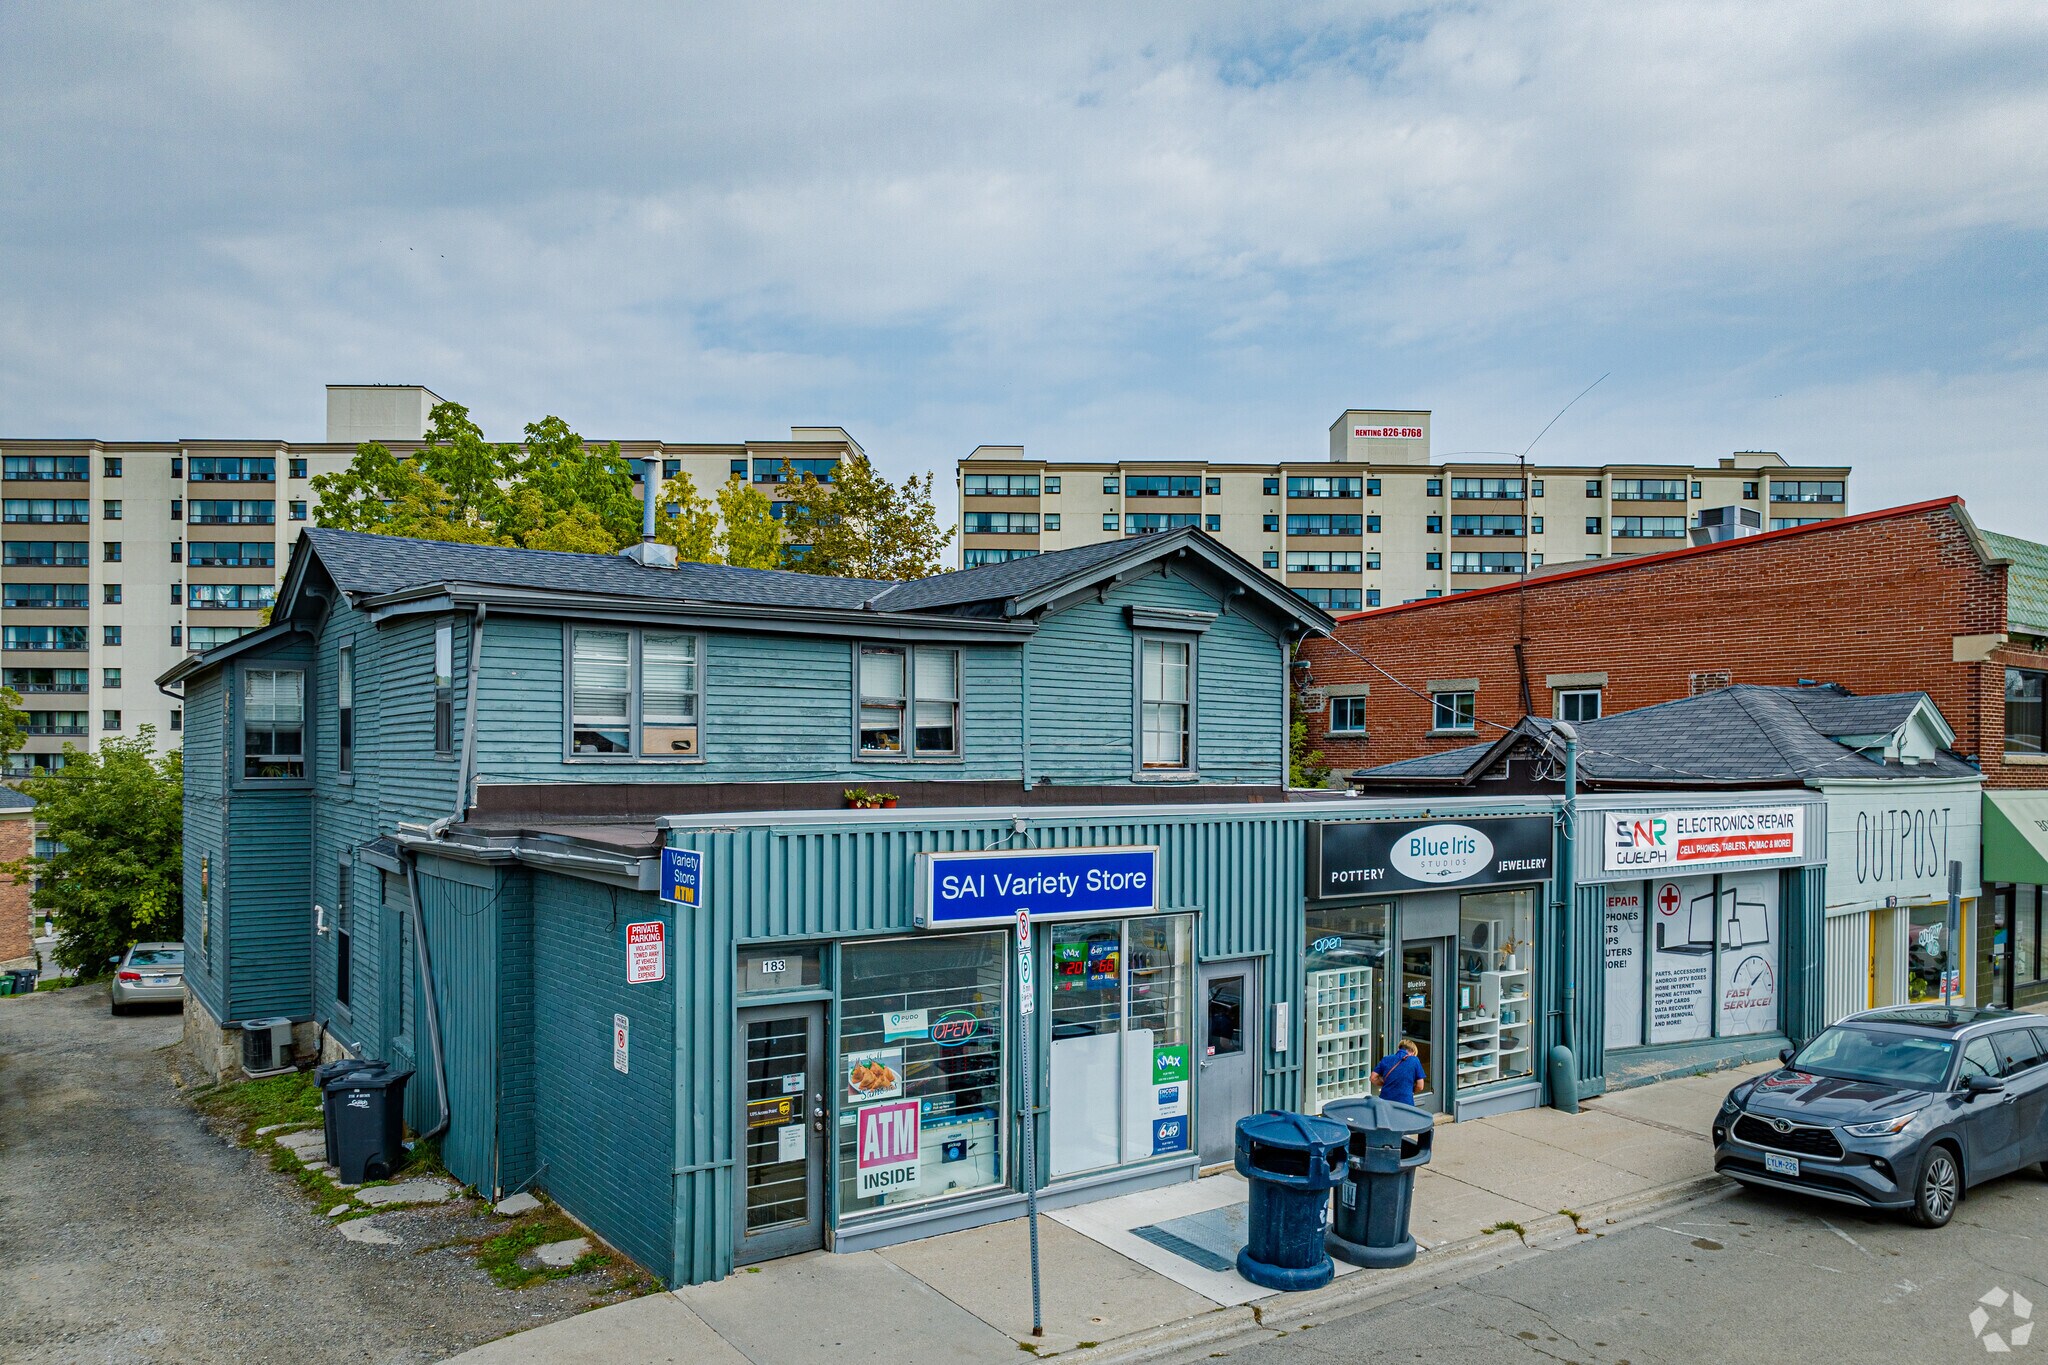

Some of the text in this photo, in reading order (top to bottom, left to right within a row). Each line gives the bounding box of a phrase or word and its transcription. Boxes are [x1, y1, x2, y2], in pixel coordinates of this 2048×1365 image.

[1355, 428, 1422, 438] RENTING 826-6768
[1676, 813, 1794, 834] ELECTRONICS REPAIR
[1616, 818, 1667, 847] SNR
[1679, 844, 1695, 855] CELL
[1696, 842, 1722, 854] PHONES,
[1722, 841, 1748, 852] TABLETS,
[1769, 841, 1774, 849] &
[1774, 839, 1791, 848] MORE!
[1856, 807, 1951, 884] OUTPOST
[671, 852, 699, 871] Variety
[1420, 858, 1467, 868] STUDIOS
[1616, 850, 1667, 865] GUELPH
[1498, 858, 1547, 873] JEWELLERY
[674, 869, 695, 885] Store
[1331, 868, 1385, 883] POTTERY
[941, 868, 1147, 900] SAI Variety Store
[674, 885, 694, 903] ATM
[1606, 912, 1638, 921] PHONES
[632, 924, 659, 934] PRIVATE
[630, 933, 660, 943] PARKING
[1314, 937, 1342, 954] open
[764, 960, 785, 972] 183
[1066, 961, 1083, 975] 20
[1099, 959, 1114, 972] 66
[1606, 960, 1627, 969] ORE!
[1673, 989, 1702, 997] ACTIVATION
[1726, 987, 1752, 999] FAST
[1723, 997, 1772, 1011] SERVICE!
[934, 1020, 974, 1039] OPEN
[1157, 1055, 1181, 1070] MAX
[863, 1108, 915, 1162] ATM
[864, 1166, 916, 1190] INSIDE
